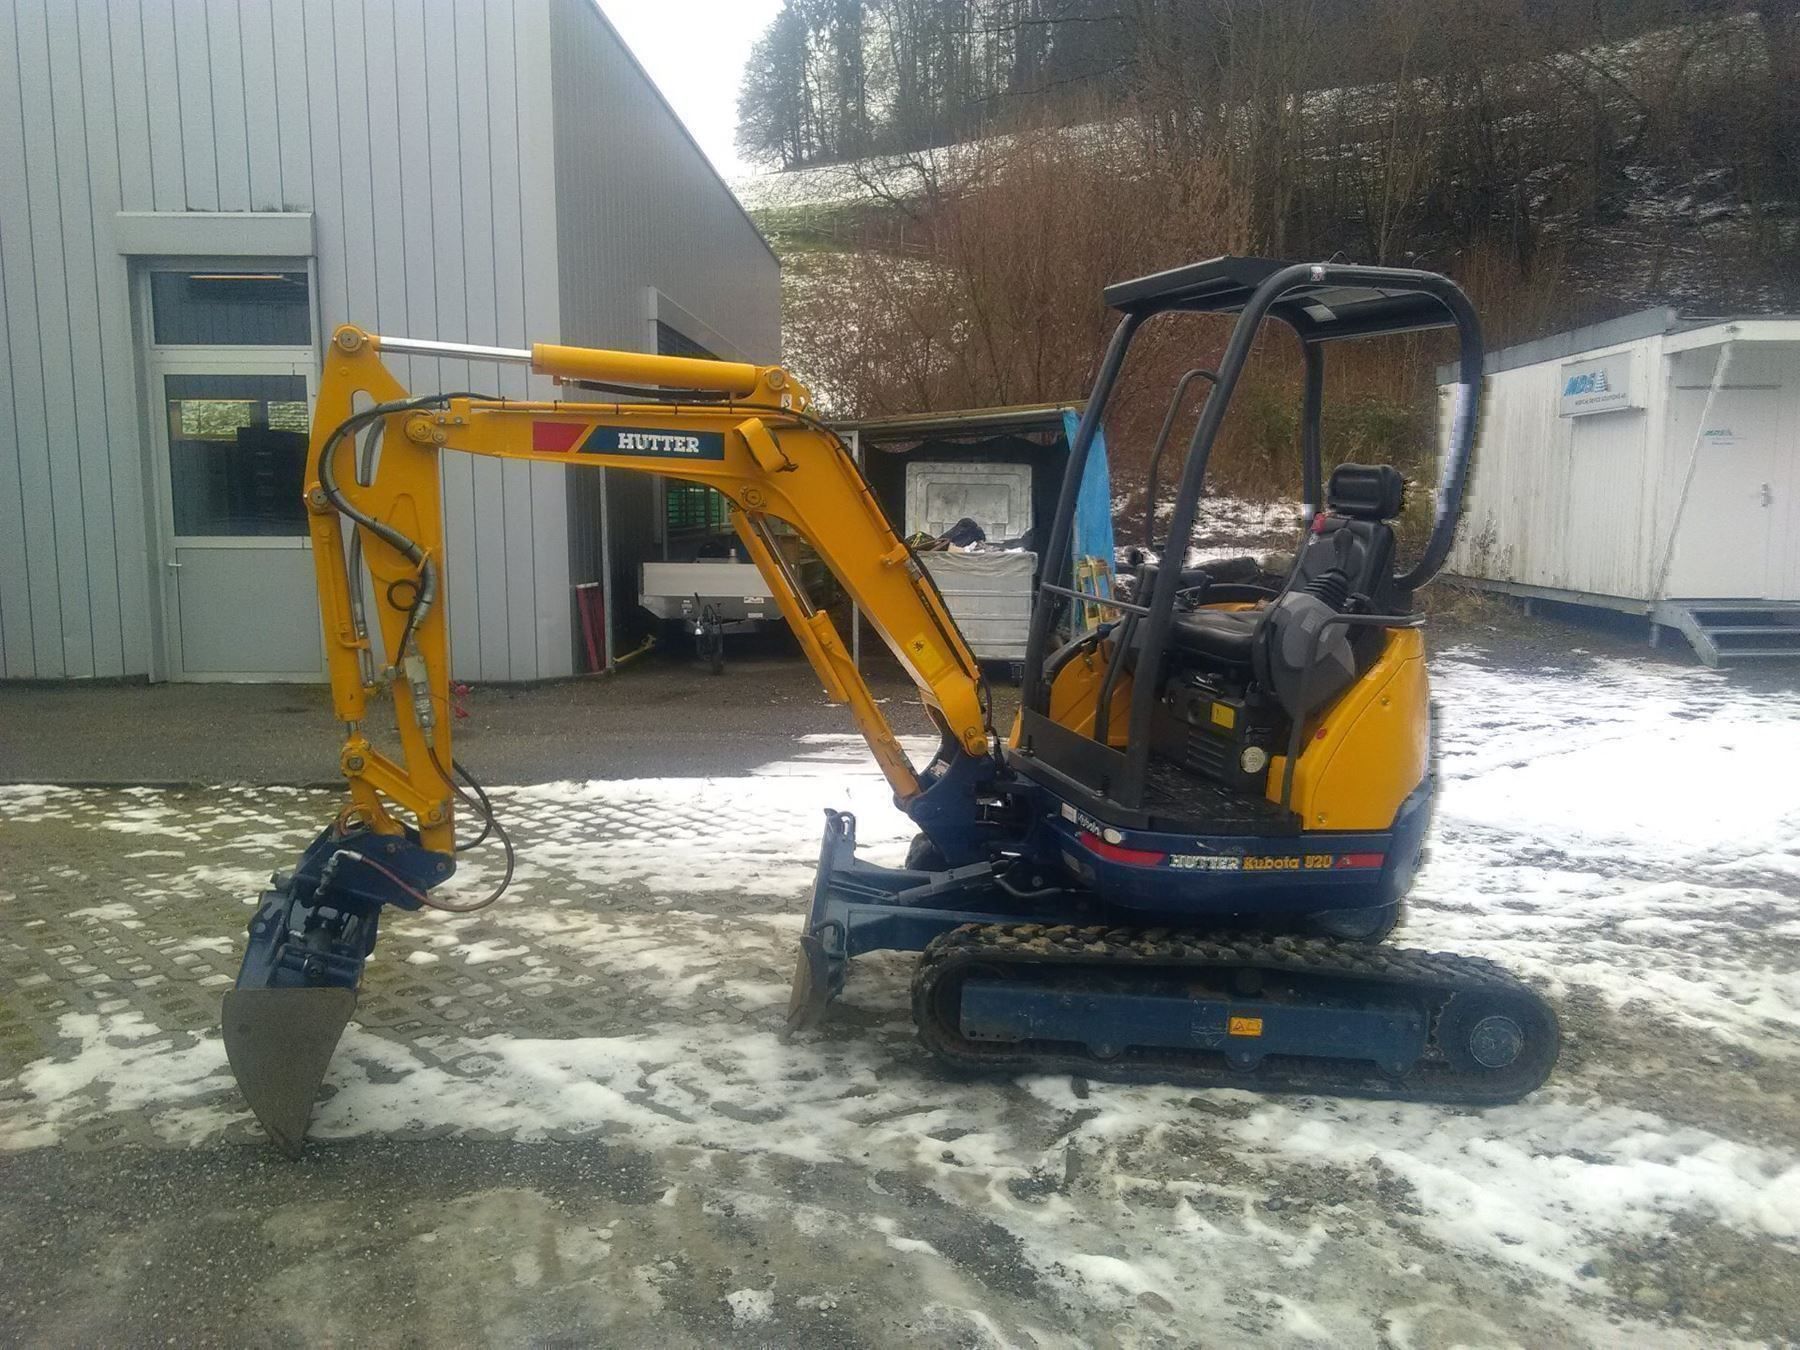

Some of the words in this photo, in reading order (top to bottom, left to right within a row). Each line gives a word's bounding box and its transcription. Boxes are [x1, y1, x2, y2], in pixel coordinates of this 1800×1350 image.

[617, 432, 700, 453] HUTTER
[1168, 854, 1239, 870] HUTTER
[1242, 856, 1300, 870] Kubota
